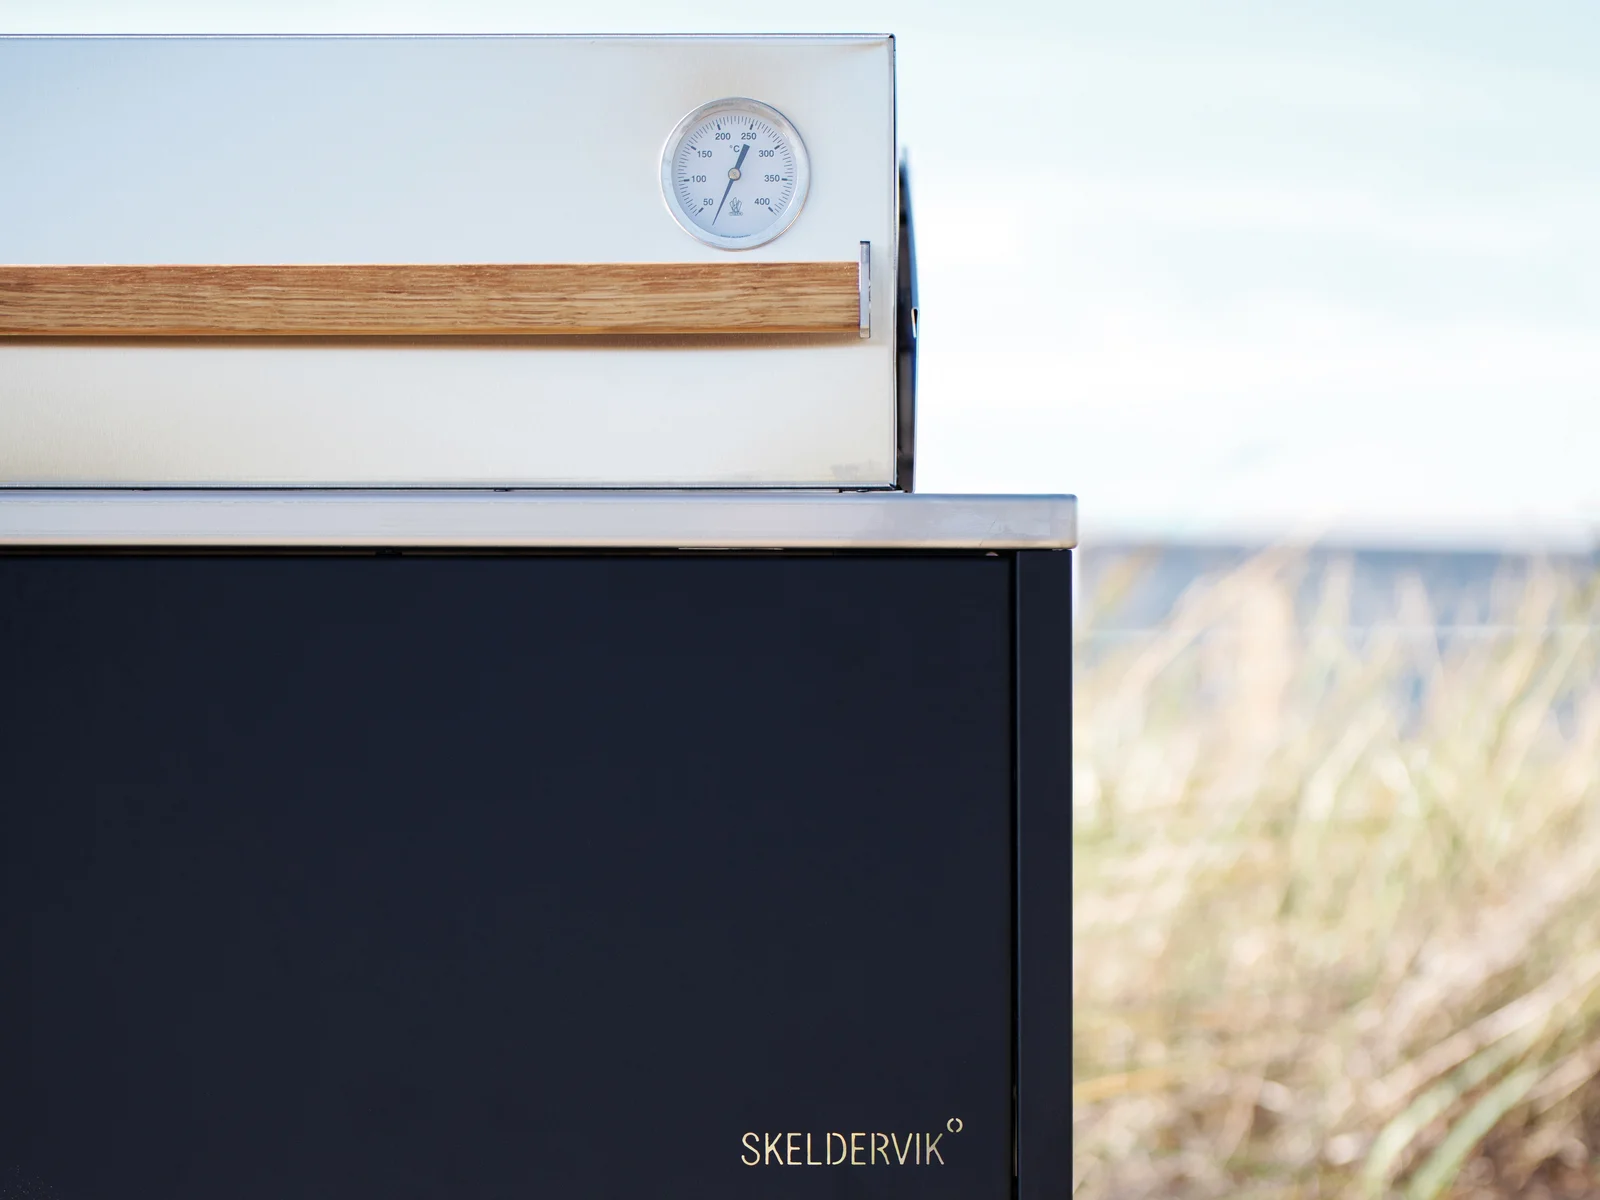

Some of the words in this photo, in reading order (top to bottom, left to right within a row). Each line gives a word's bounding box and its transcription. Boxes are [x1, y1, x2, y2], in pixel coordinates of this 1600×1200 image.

[715, 132, 731, 140] 200
[741, 132, 757, 140] 250
[697, 150, 712, 158] 150
[758, 150, 774, 158] 300
[691, 175, 707, 183] 100
[764, 174, 780, 182] 350
[703, 198, 714, 206] 50
[754, 197, 770, 206] 400
